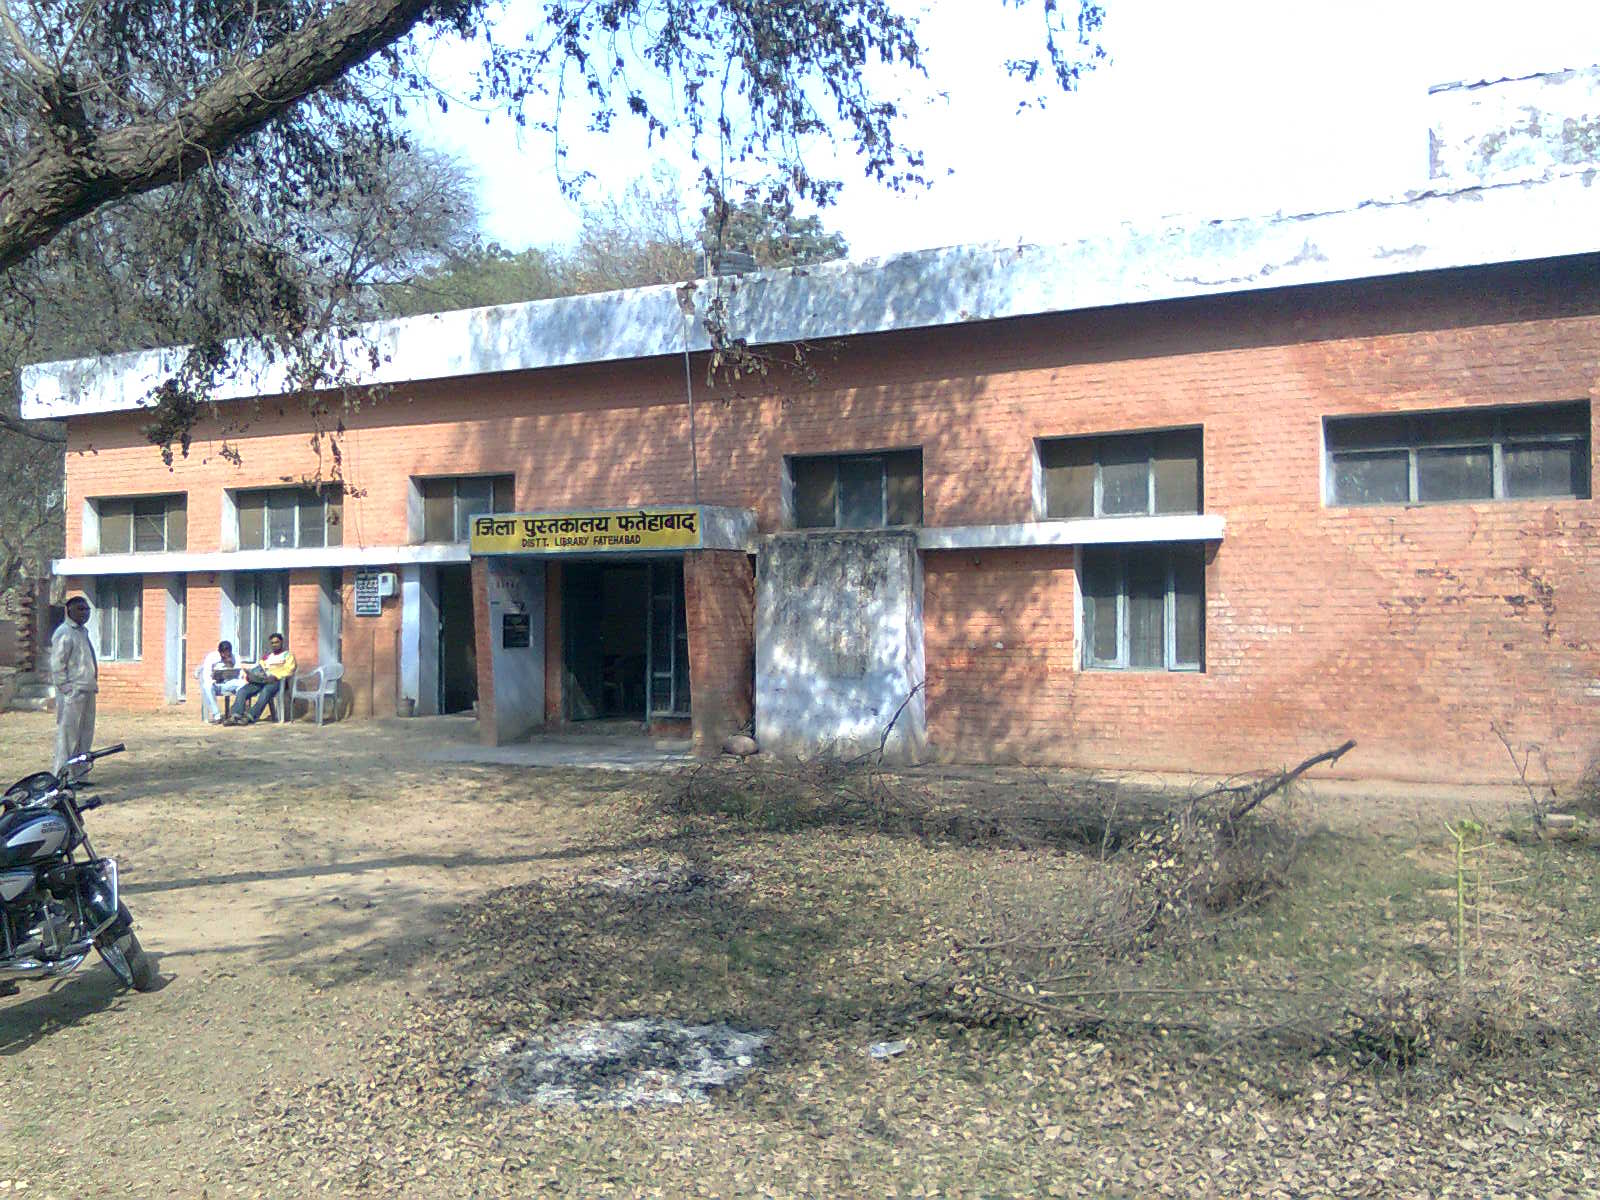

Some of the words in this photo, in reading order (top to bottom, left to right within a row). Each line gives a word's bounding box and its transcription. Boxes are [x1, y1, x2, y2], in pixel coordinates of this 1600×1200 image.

[475, 517, 517, 536] जिला
[523, 516, 611, 537] पुस्तकालय
[616, 510, 697, 534] फतेहाबाद
[521, 537, 549, 548] DISTT.
[555, 535, 590, 547] LIBRARY
[593, 534, 641, 546] FATEHABAD
